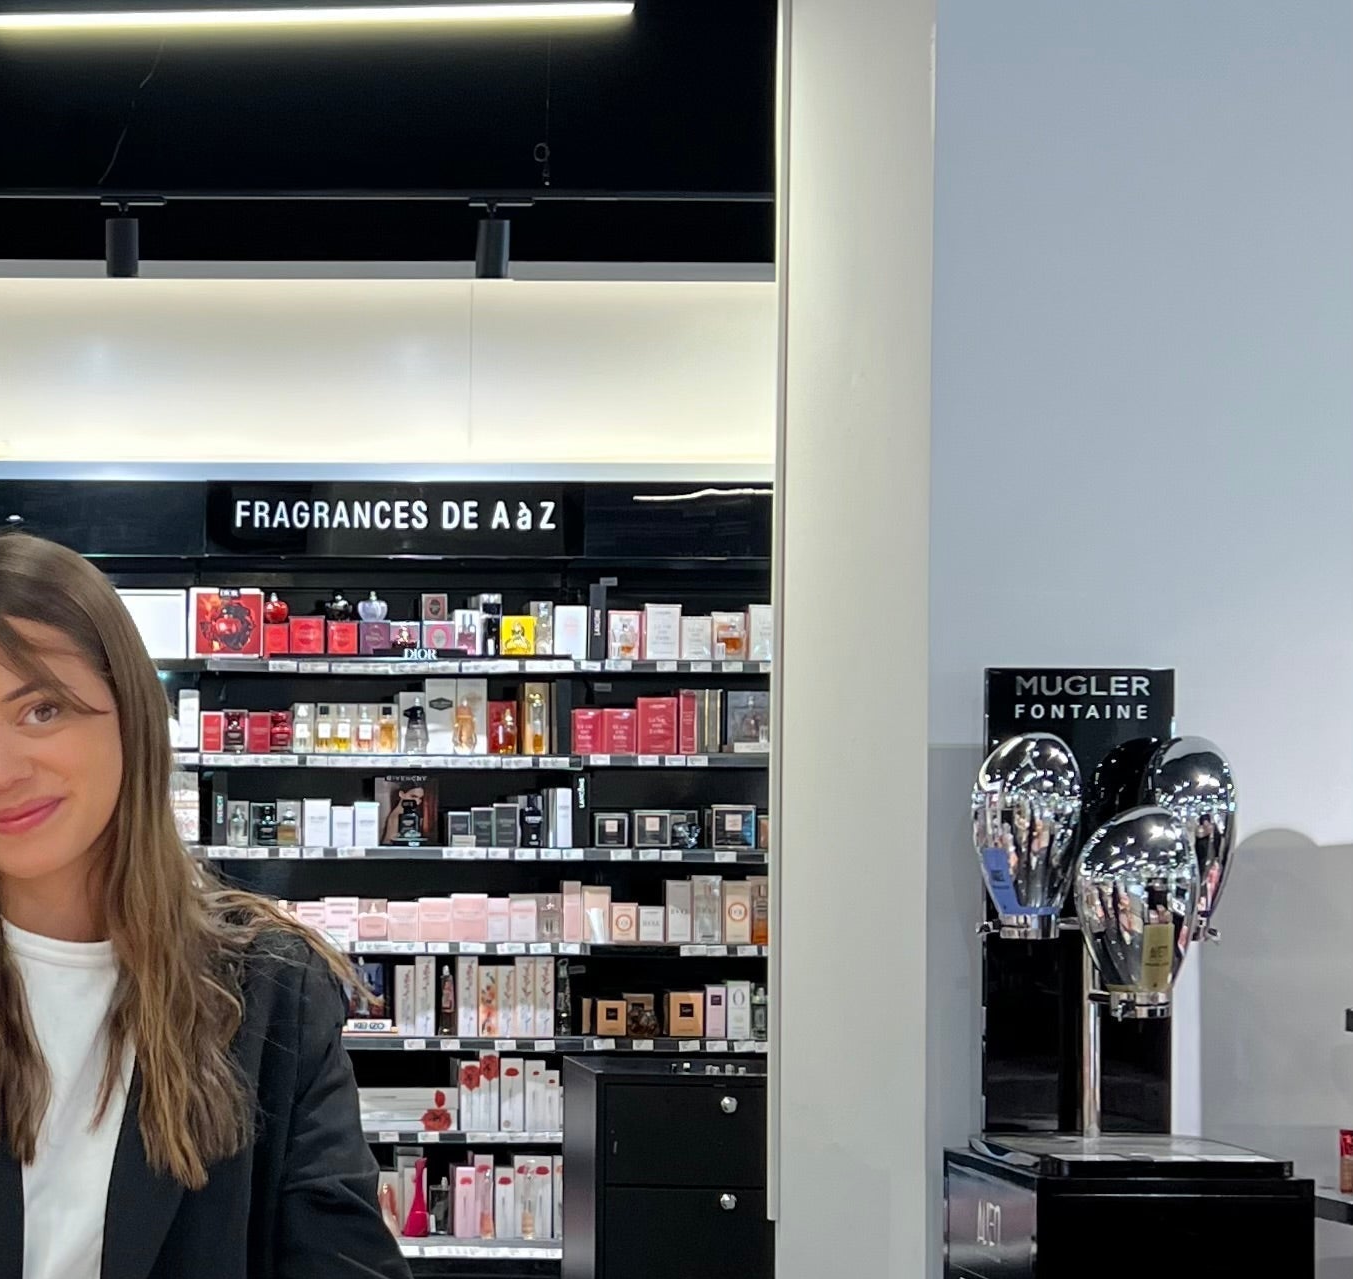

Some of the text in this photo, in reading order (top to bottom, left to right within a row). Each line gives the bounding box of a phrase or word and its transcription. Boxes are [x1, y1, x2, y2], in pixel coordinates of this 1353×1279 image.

[235, 500, 428, 529] FRAGRANCES
[442, 501, 479, 530] DE
[403, 648, 438, 660] DIOR
[1015, 675, 1151, 697] MUGLER
[1014, 703, 1148, 719] FONTAINE
